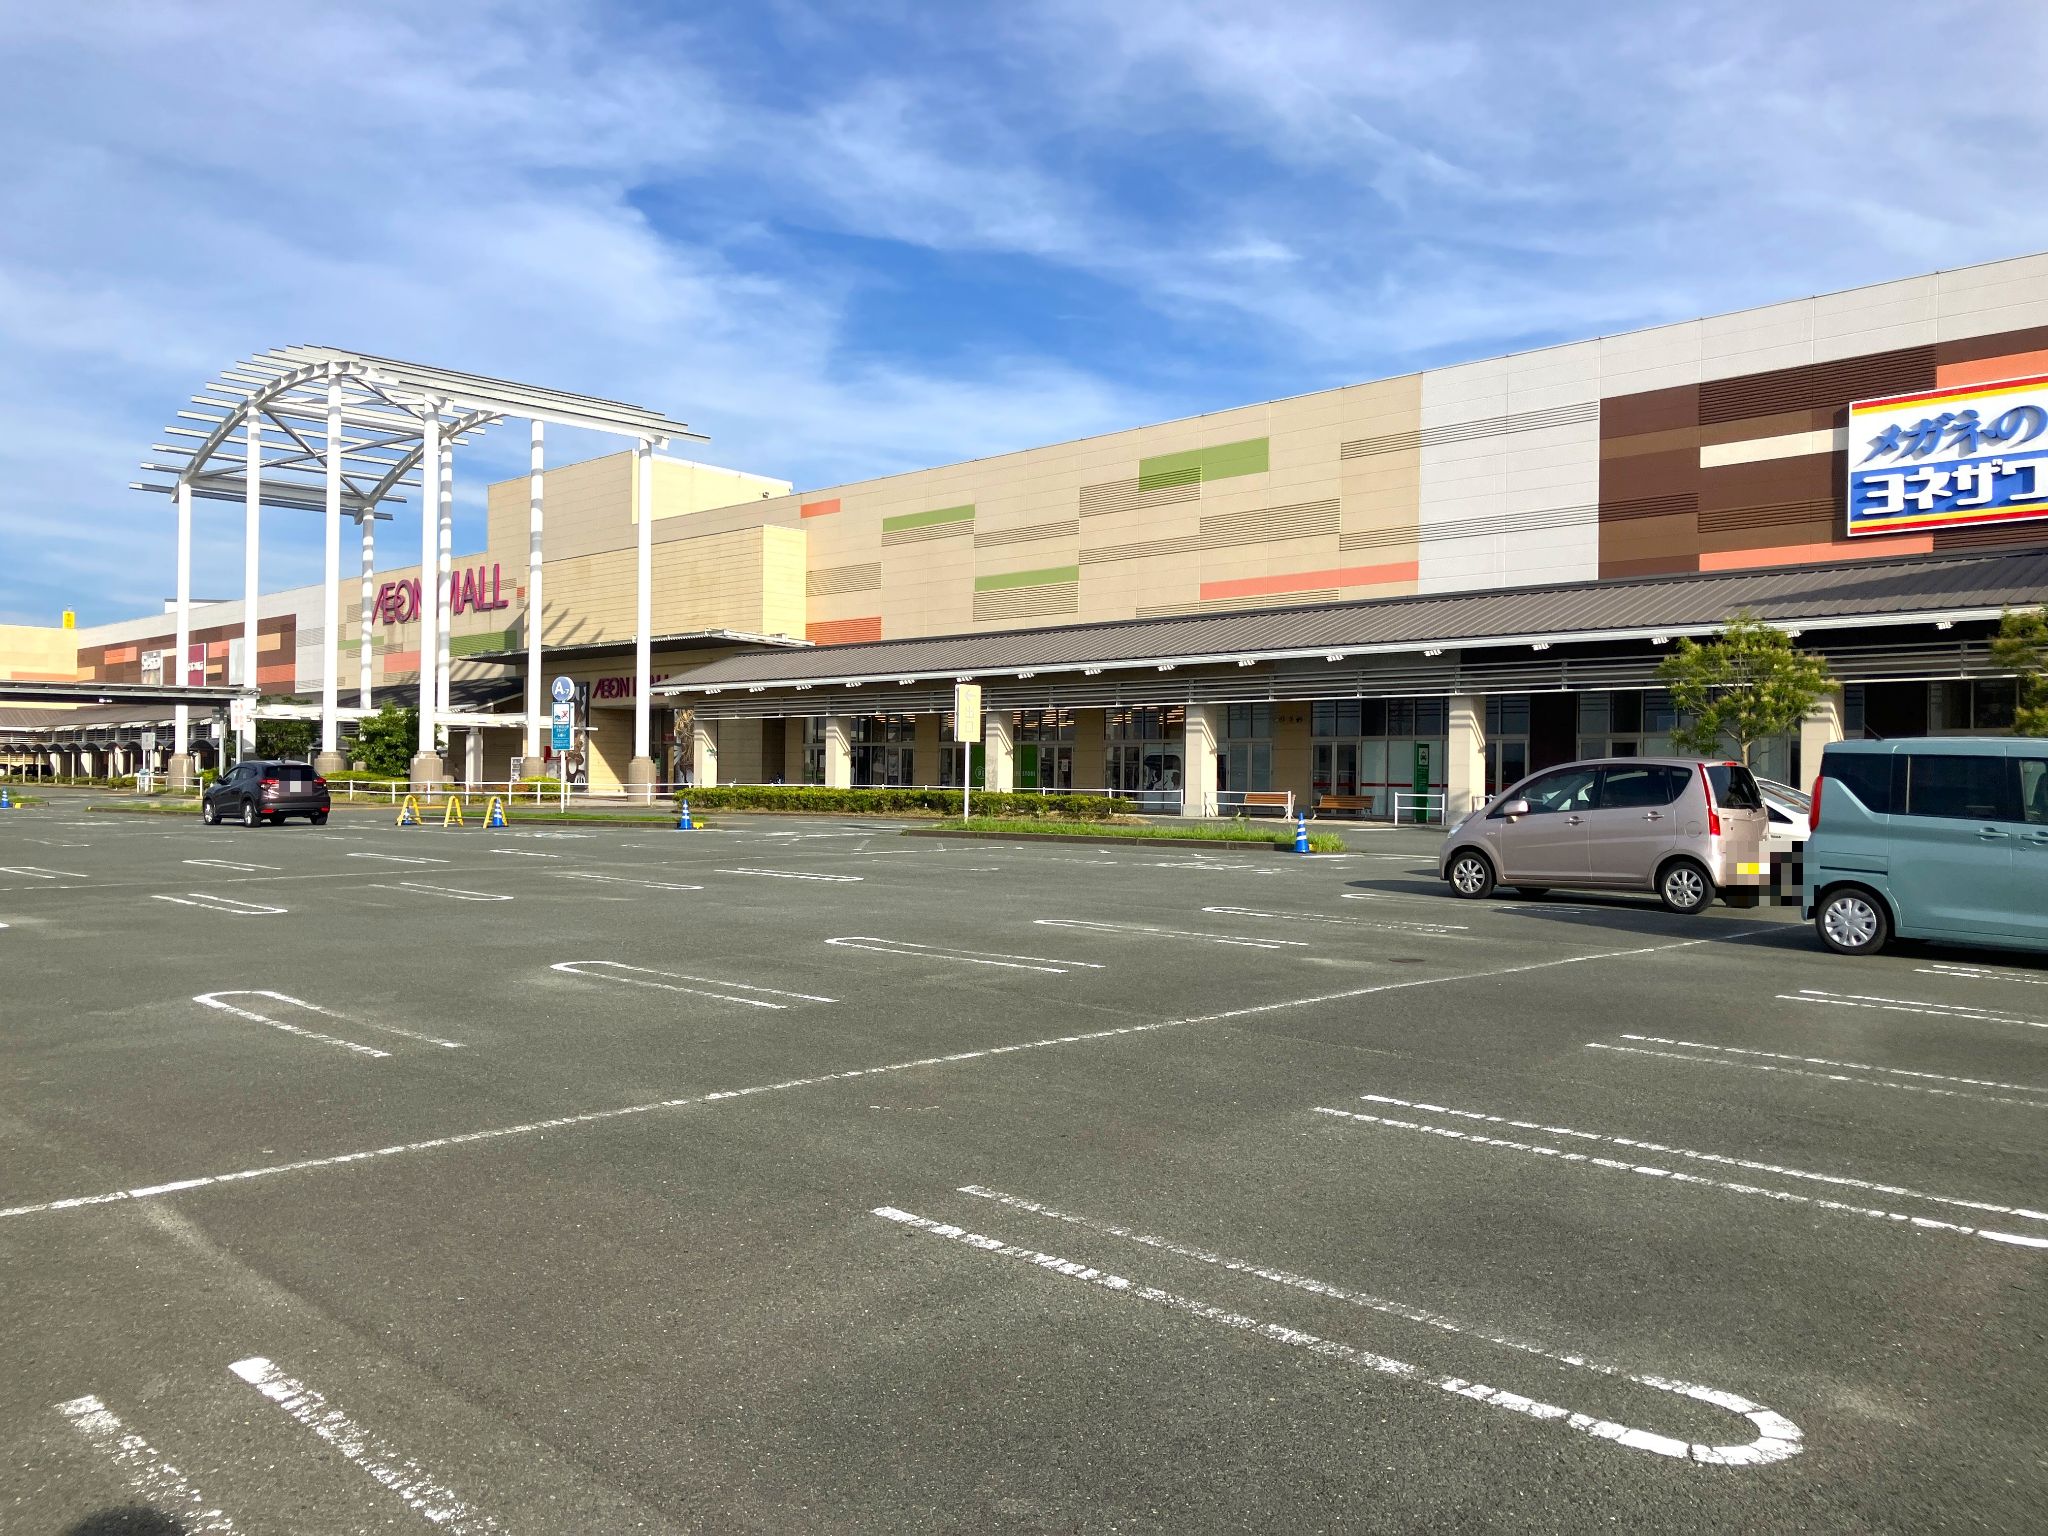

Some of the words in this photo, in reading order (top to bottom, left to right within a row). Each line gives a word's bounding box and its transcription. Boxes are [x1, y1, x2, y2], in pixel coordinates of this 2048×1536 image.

[1856, 405, 2048, 467] メガネの
[964, 704, 974, 733] 出口
